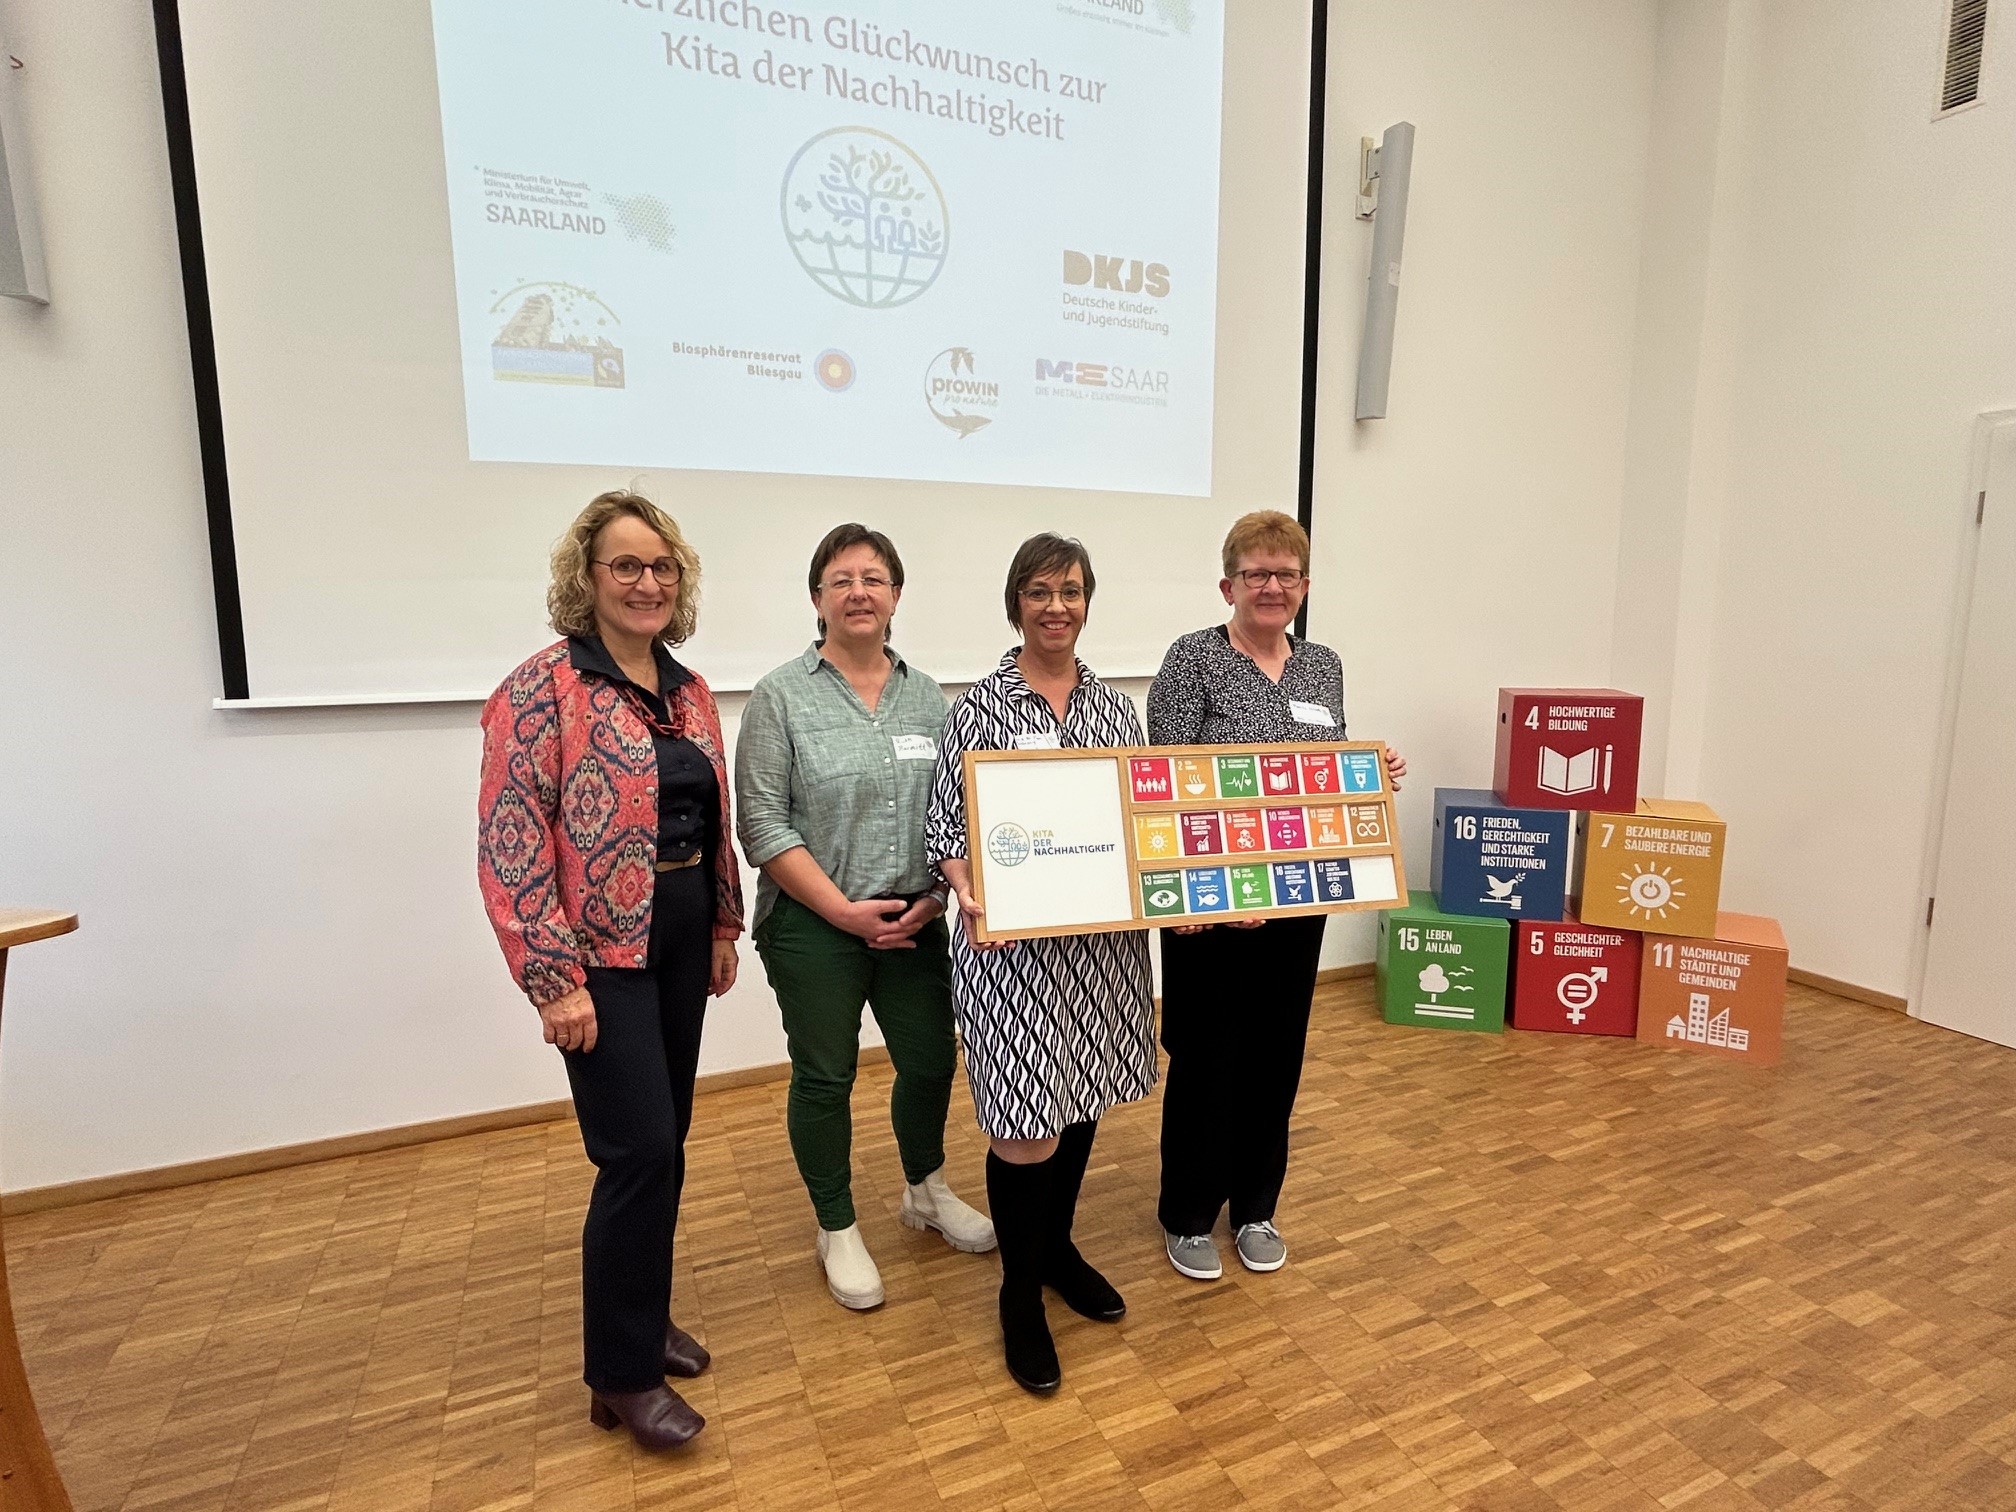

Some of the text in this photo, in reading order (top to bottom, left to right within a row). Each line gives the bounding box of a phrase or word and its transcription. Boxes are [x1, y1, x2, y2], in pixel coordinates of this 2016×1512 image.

[622, 0, 813, 42] zlichen
[824, 16, 1050, 92] Glückwunsch
[1059, 74, 1107, 103] zur
[661, 31, 1064, 140] Kita der Nachhaltigkeit
[483, 168, 539, 182] Ministerium
[485, 190, 588, 209] und Verbraucherschutz
[486, 203, 606, 235] SAARLAND
[1063, 250, 1170, 298] DKJS
[1063, 292, 1158, 315] Deutsche Kinder-
[1063, 311, 1169, 336] und Jugendstiftung
[672, 342, 801, 364] Biosphärenreservat
[747, 365, 802, 380] Bliesgau
[1524, 705, 1539, 730] 4
[1549, 706, 1616, 718] HOCHWERTIGE
[1548, 719, 1588, 731] BILDUNG
[1134, 762, 1139, 772] 1
[1178, 761, 1183, 771] 2
[1221, 759, 1226, 769] 3
[1262, 758, 1268, 768] 4
[1303, 757, 1309, 766] 5
[1226, 814, 1232, 823] 9
[1268, 811, 1277, 821] 10
[1310, 809, 1316, 818] 11
[1350, 807, 1358, 817] 12
[1184, 816, 1189, 826] 8
[1454, 815, 1476, 840] 16
[1483, 817, 1521, 829] FRIEDEN,
[1032, 830, 1054, 838] KITA
[1482, 830, 1550, 844] GERECHTIGKEIT
[1601, 823, 1614, 848] 7
[1626, 825, 1712, 843] BEZAHLBARE UND
[1034, 839, 1052, 847] DER
[1482, 843, 1535, 856] UND STARKE
[1624, 839, 1711, 857] SAUBERE ENERGIE
[1034, 844, 1115, 856] NACHHALTIGKEIT
[1317, 863, 1324, 873] 17
[1481, 856, 1546, 870] INSTITUTIONEN
[1143, 875, 1152, 885] 13
[1189, 872, 1197, 882] 14
[1232, 869, 1241, 879] 15
[1398, 927, 1419, 951] 15
[1425, 929, 1453, 941] LEBEN
[1554, 932, 1624, 946] GESCHLECHTER-
[1425, 942, 1462, 955] AN LAND
[1530, 931, 1544, 955] 5
[1553, 945, 1604, 958] GLEICHHEIT
[1653, 942, 1674, 968] 11
[1681, 945, 1751, 966] NACHHALTIGE
[1680, 959, 1741, 978] STÄDTE UND
[1679, 972, 1737, 991] GEMEINDEN
